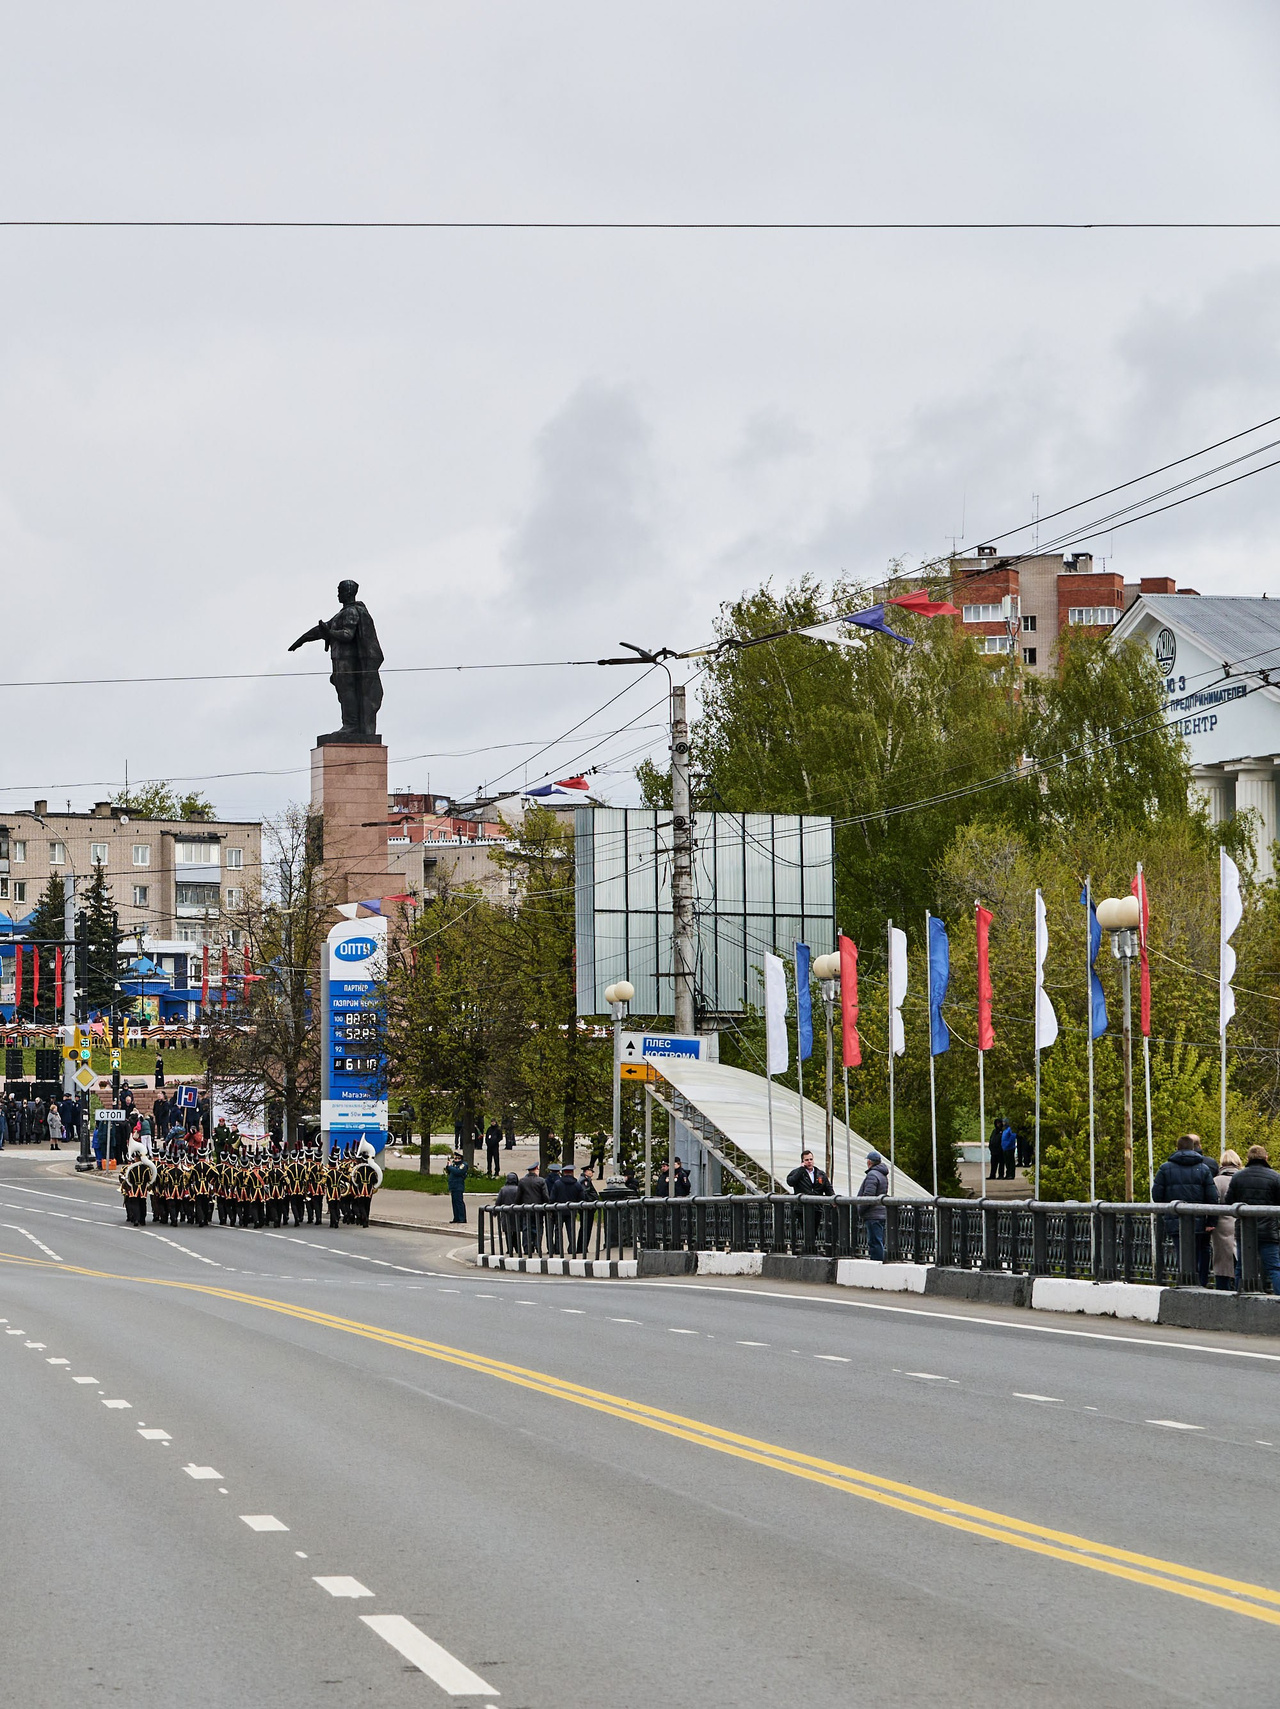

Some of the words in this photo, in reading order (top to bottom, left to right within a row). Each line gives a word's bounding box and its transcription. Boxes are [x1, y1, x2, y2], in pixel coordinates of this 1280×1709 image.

[334, 1015, 343, 1023] 100
[335, 1030, 342, 1038] 95
[646, 1039, 671, 1048] ПЛЕС
[99, 1111, 122, 1119] СТОП
